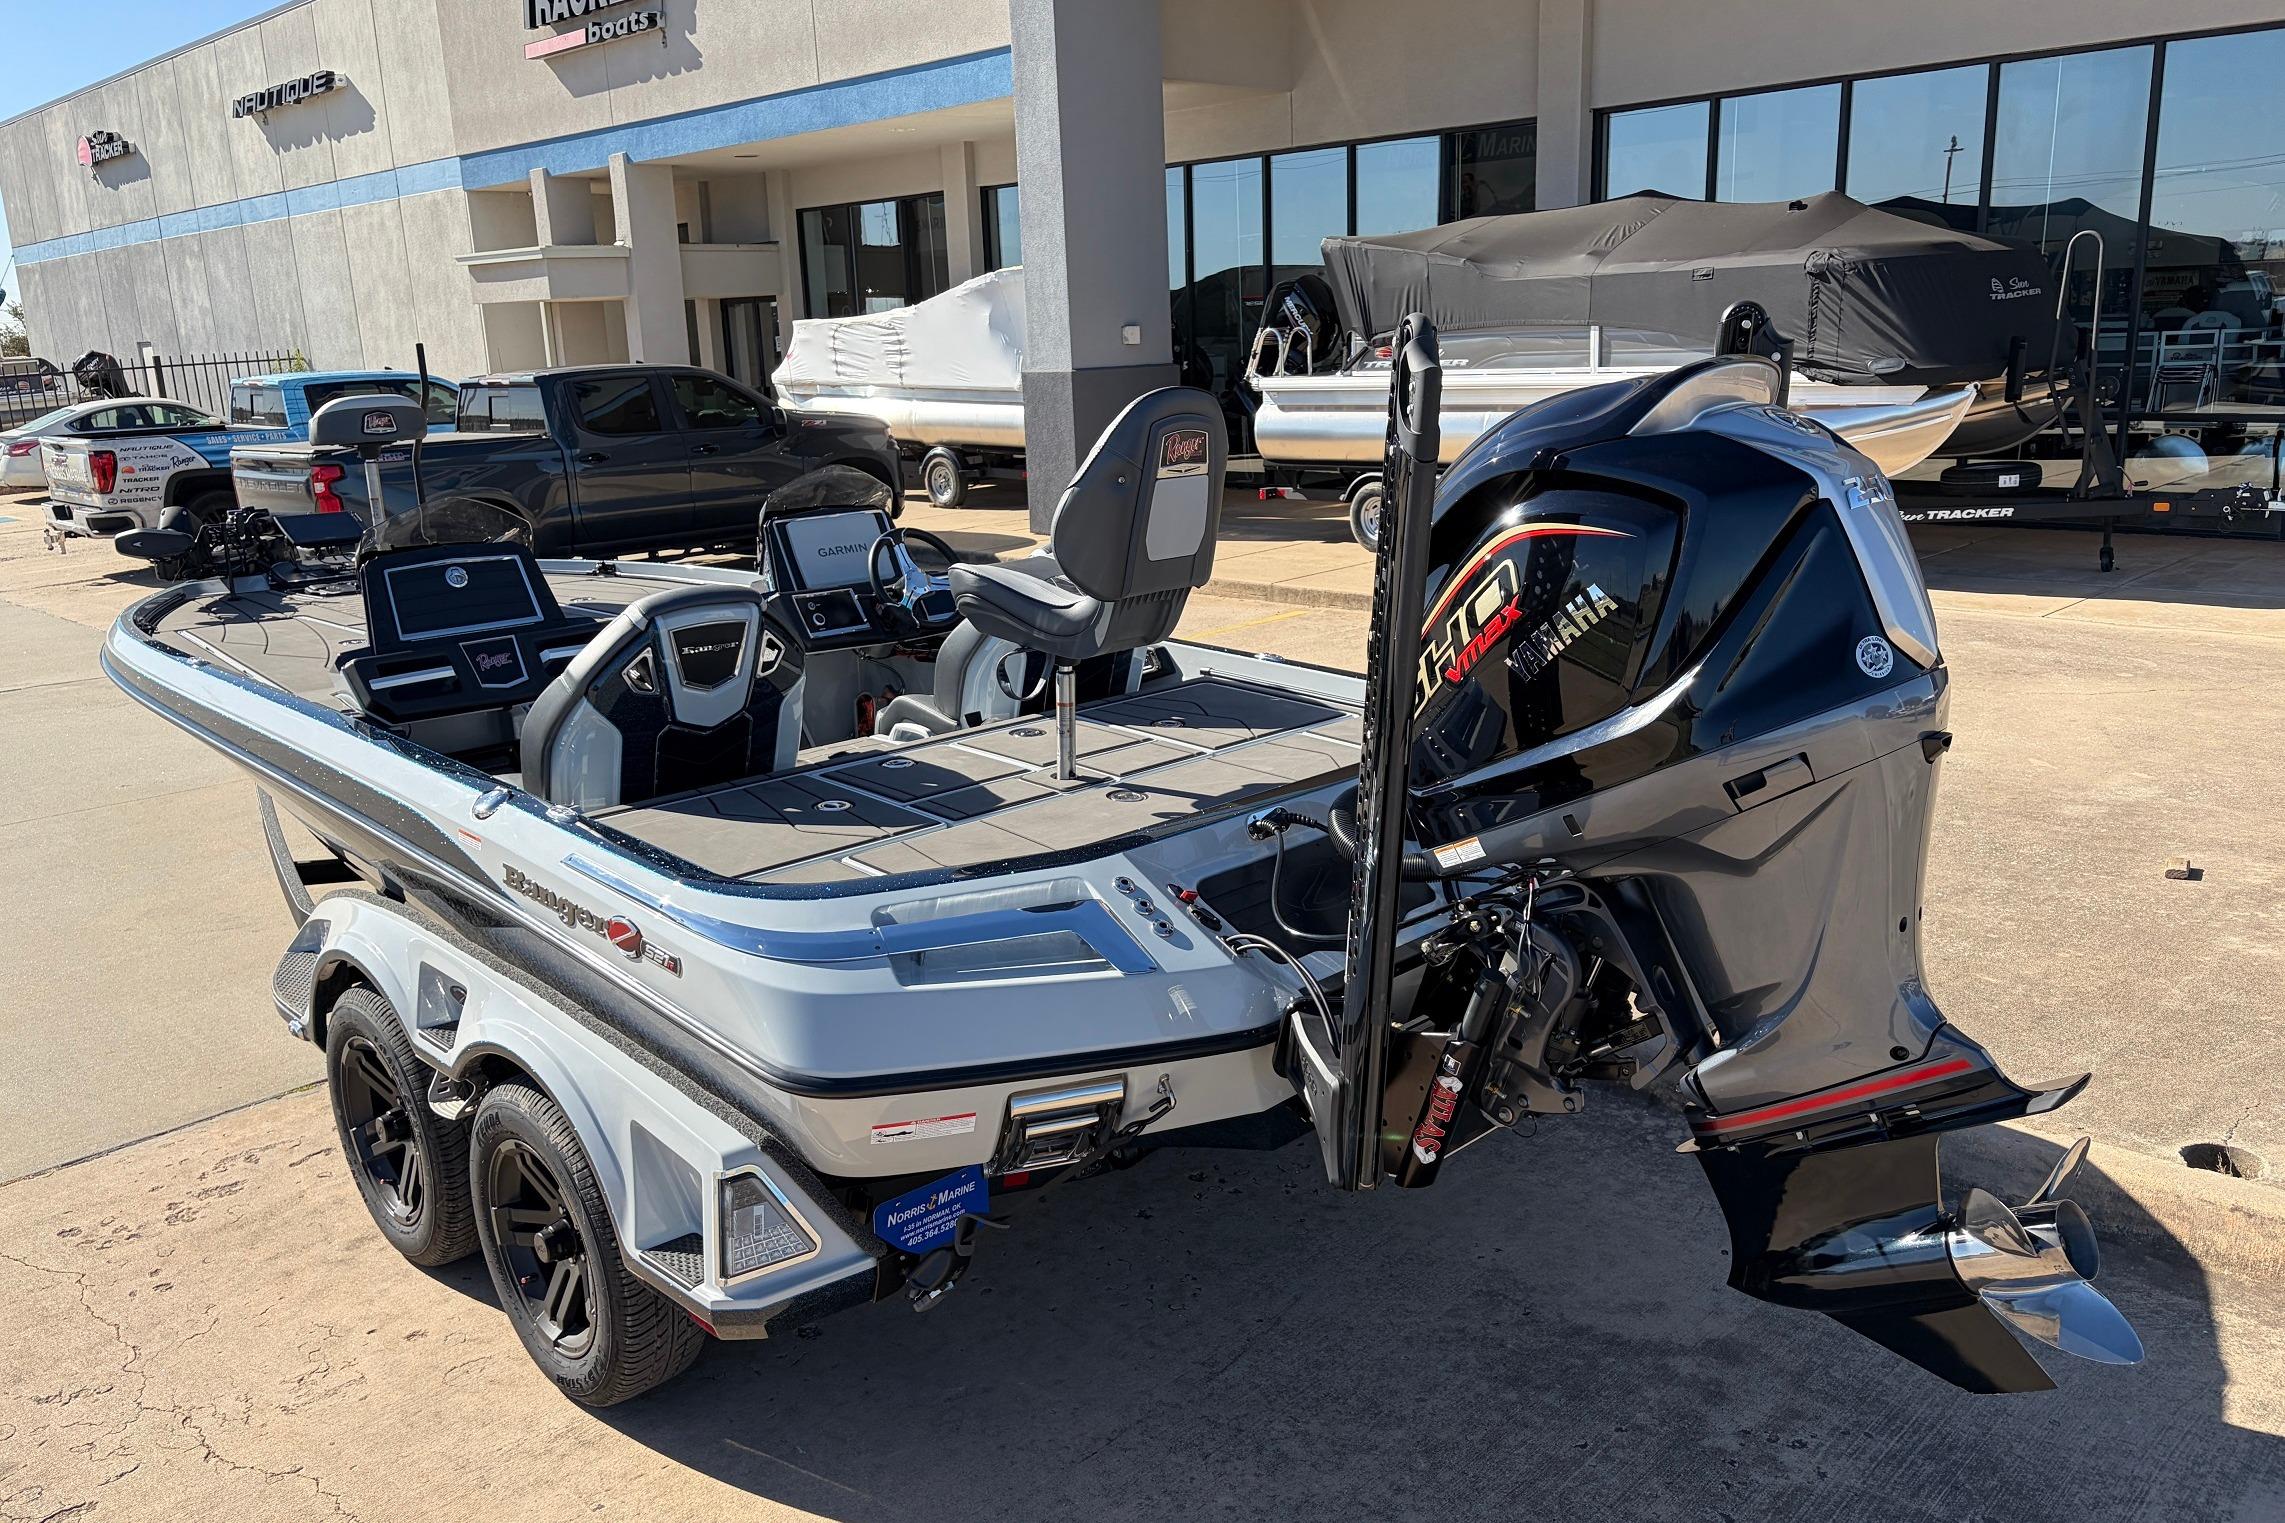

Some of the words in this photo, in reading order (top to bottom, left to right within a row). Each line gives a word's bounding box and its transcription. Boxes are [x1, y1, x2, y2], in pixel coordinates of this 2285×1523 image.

[588, 12, 649, 44] boats
[233, 70, 330, 118] NAUTIQUE
[91, 141, 124, 162] TRACKER
[2009, 277, 2030, 290] Sun
[1989, 288, 2042, 300] TRACKER
[206, 435, 228, 445] SALES
[232, 433, 260, 443] SERVICE
[265, 431, 287, 441] PARTS
[119, 444, 174, 452] NAUTIQUE
[170, 455, 196, 469] Ranger
[120, 495, 163, 504] REGENCY
[1927, 507, 2015, 520] TRACKER
[818, 543, 868, 558] GARMIN
[1504, 583, 1619, 682] YAMAHA
[682, 641, 740, 655] Ranger
[502, 863, 609, 938] Ranger
[1413, 1075, 1459, 1154] ATLAS
[887, 1203, 926, 1228] NORRIS
[938, 1181, 976, 1206] MARINE
[922, 1207, 951, 1225] NORMAN,
[952, 1202, 962, 1212] OK
